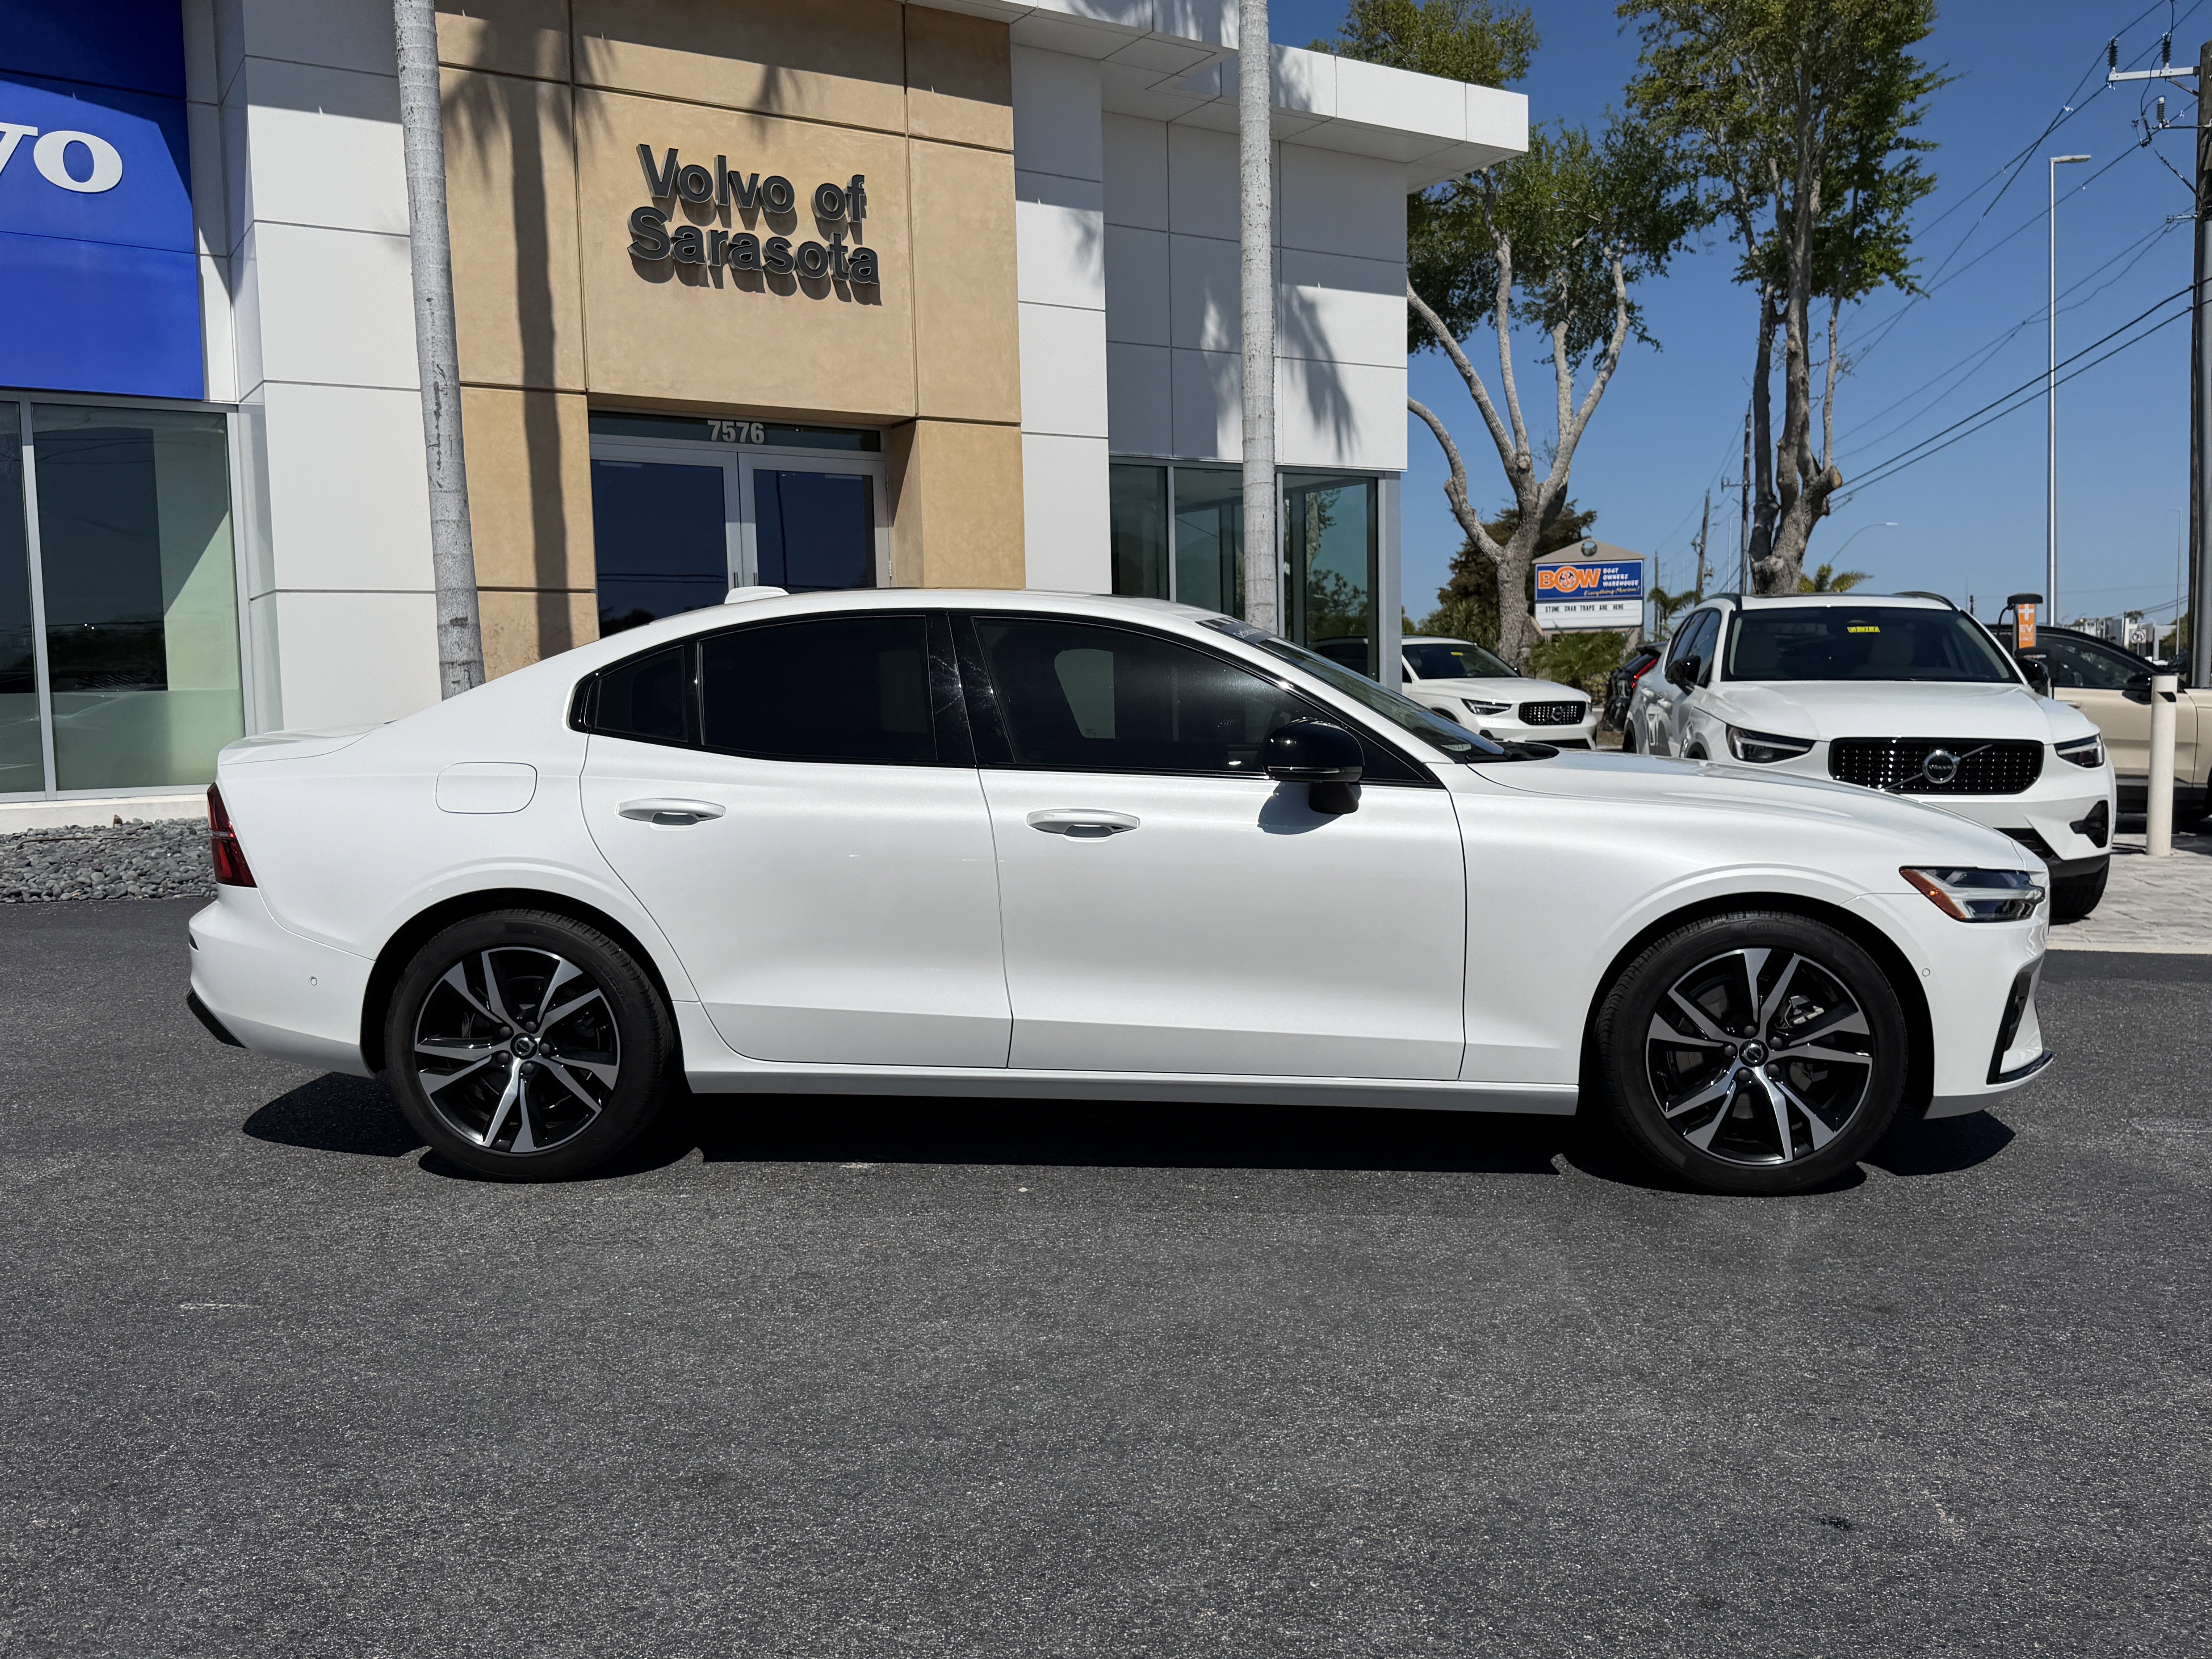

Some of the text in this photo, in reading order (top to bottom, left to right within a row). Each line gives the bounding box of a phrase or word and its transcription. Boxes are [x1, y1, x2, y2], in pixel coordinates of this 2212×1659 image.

[636, 144, 866, 223] Volvo of
[627, 206, 880, 284] Sarasota
[707, 420, 765, 444] 7576
[1538, 566, 1601, 593] BOW
[2020, 624, 2033, 633] EV
